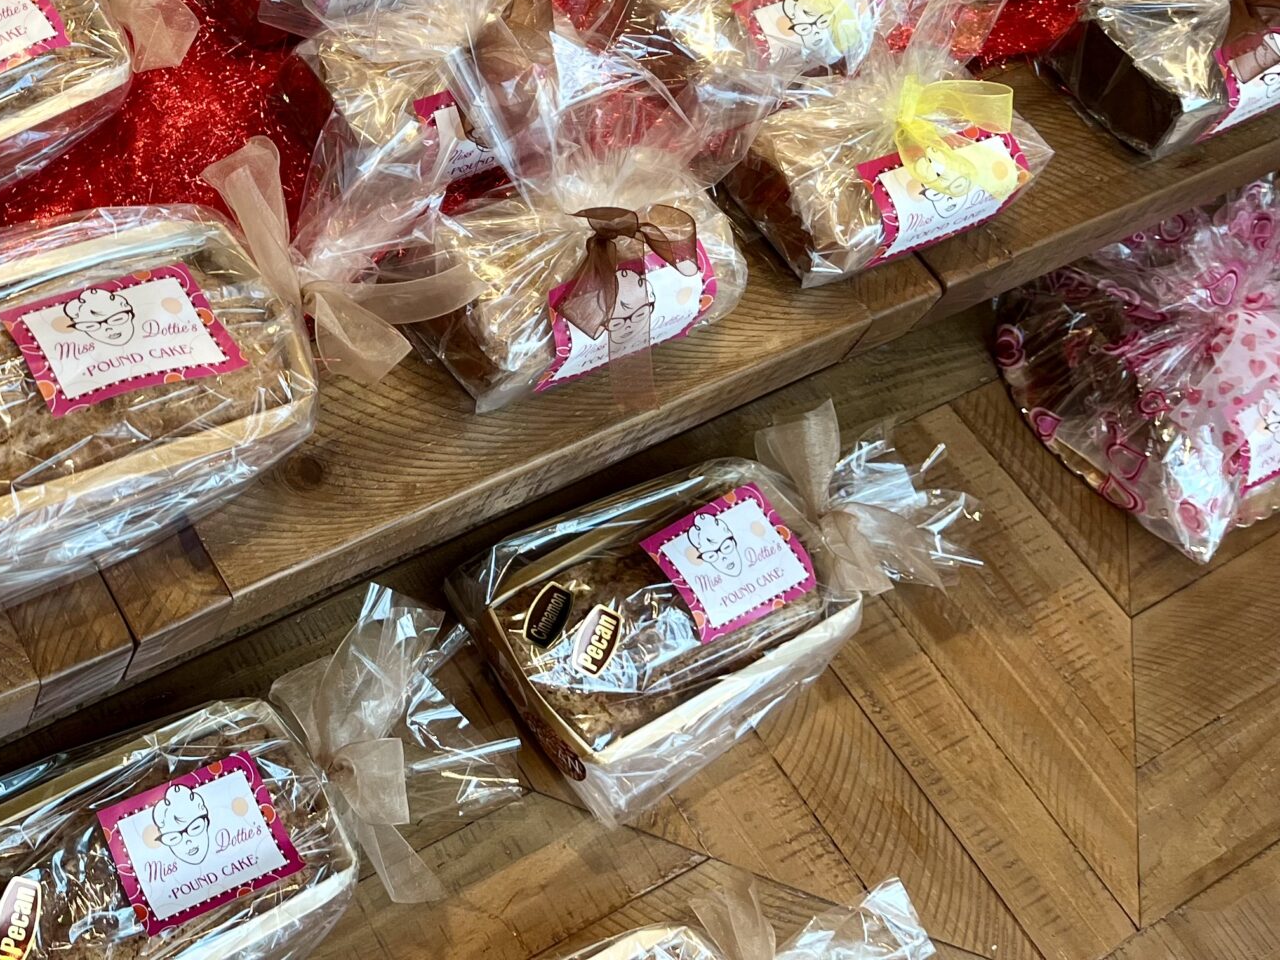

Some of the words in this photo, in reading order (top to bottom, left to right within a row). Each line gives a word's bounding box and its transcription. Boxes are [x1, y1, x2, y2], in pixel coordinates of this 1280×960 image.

[54, 341, 96, 361] Miss
[142, 319, 198, 339] Dottie's
[86, 351, 144, 377] POUND
[148, 343, 192, 359] CAKE
[694, 573, 723, 594] Miss
[743, 539, 783, 569] Dottie's
[721, 583, 756, 608] POUND
[756, 567, 784, 587] CAKE
[530, 591, 567, 641] Cinnamon
[577, 613, 618, 673] Pecan
[144, 859, 178, 884] Miss
[215, 821, 264, 854] Dottie's
[171, 871, 219, 900] POUND
[221, 854, 257, 878] CAKE
[0, 886, 37, 957] Pecan
